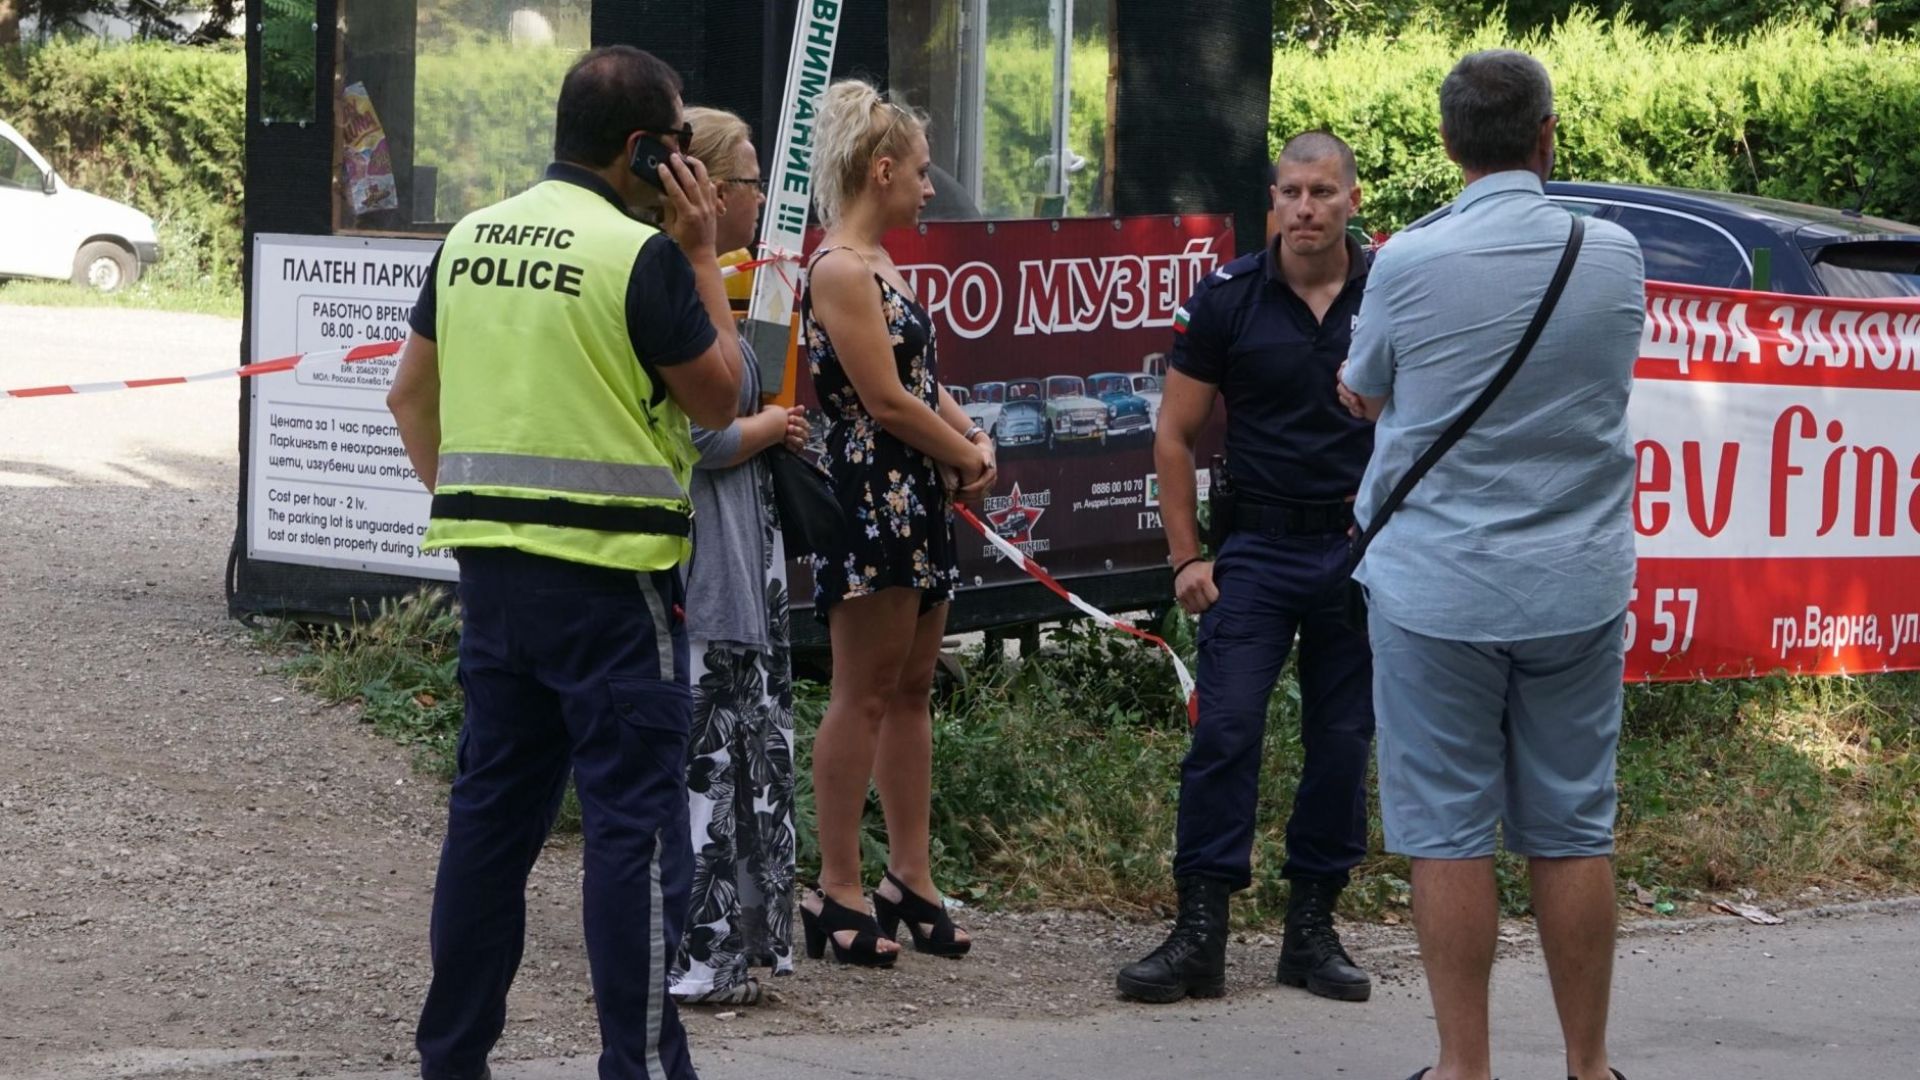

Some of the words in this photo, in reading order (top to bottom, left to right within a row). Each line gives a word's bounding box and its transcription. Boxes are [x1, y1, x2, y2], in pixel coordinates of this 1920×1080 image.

[783, 0, 838, 195] ВНИМАНИЕ
[474, 224, 575, 249] TRAFFIC
[283, 258, 355, 284] ПЛАТЕН
[448, 257, 584, 297] POLICE
[1013, 237, 1219, 335] МУЗЕЙ
[313, 302, 372, 320] РАБОТНО
[321, 322, 353, 338] 08.00
[270, 414, 313, 430] Цената
[315, 420, 328, 431] за
[331, 419, 335, 432] 1
[339, 422, 359, 434] час
[270, 434, 328, 451] Паркингът
[331, 441, 338, 451] е
[269, 455, 304, 470] щети,
[307, 458, 354, 473] изгубени
[357, 464, 376, 475] или
[379, 464, 423, 482] откра
[1769, 405, 1920, 538] fin
[268, 489, 291, 502] Cost
[294, 493, 311, 506] per
[313, 494, 336, 507] hour
[346, 497, 354, 508] 2
[356, 497, 367, 510] lv.
[268, 508, 285, 521] The
[288, 512, 327, 529] parking
[330, 514, 343, 528] lot
[345, 516, 353, 529] is
[356, 520, 414, 536] unguarded
[268, 528, 285, 541] lost
[287, 532, 298, 542] or
[300, 533, 331, 546] stolen
[334, 537, 378, 552] property
[381, 540, 414, 558] during
[1651, 588, 1698, 653] 57
[1771, 605, 1883, 659] гр.Варна,
[1889, 613, 1920, 656] ул
